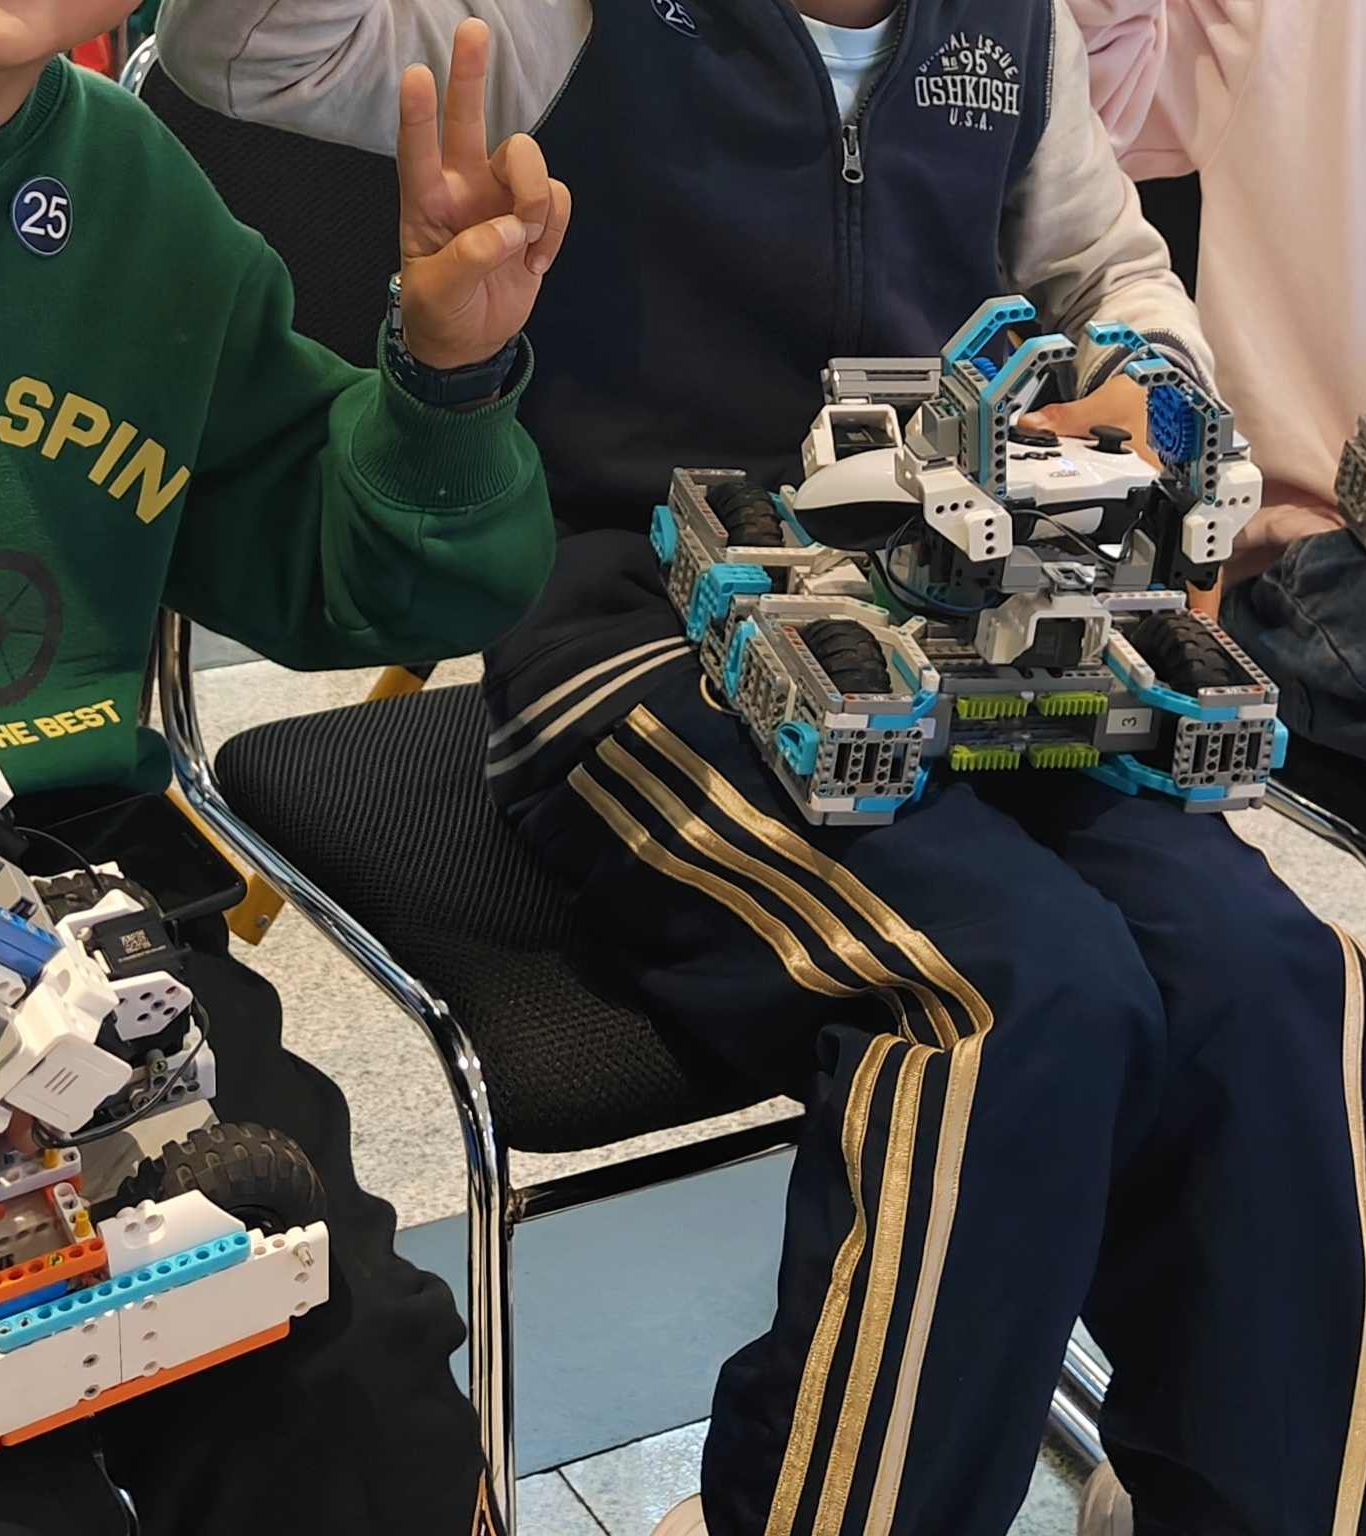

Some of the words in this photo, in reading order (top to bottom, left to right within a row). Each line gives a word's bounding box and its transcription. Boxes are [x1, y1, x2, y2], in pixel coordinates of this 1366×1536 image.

[959, 48, 988, 75] 95
[977, 33, 1019, 80] ISSUE
[915, 74, 1020, 116] OSHKOSH
[949, 106, 993, 131] U.S.A.
[20, 190, 68, 239] 25
[33, 699, 122, 739] BEST
